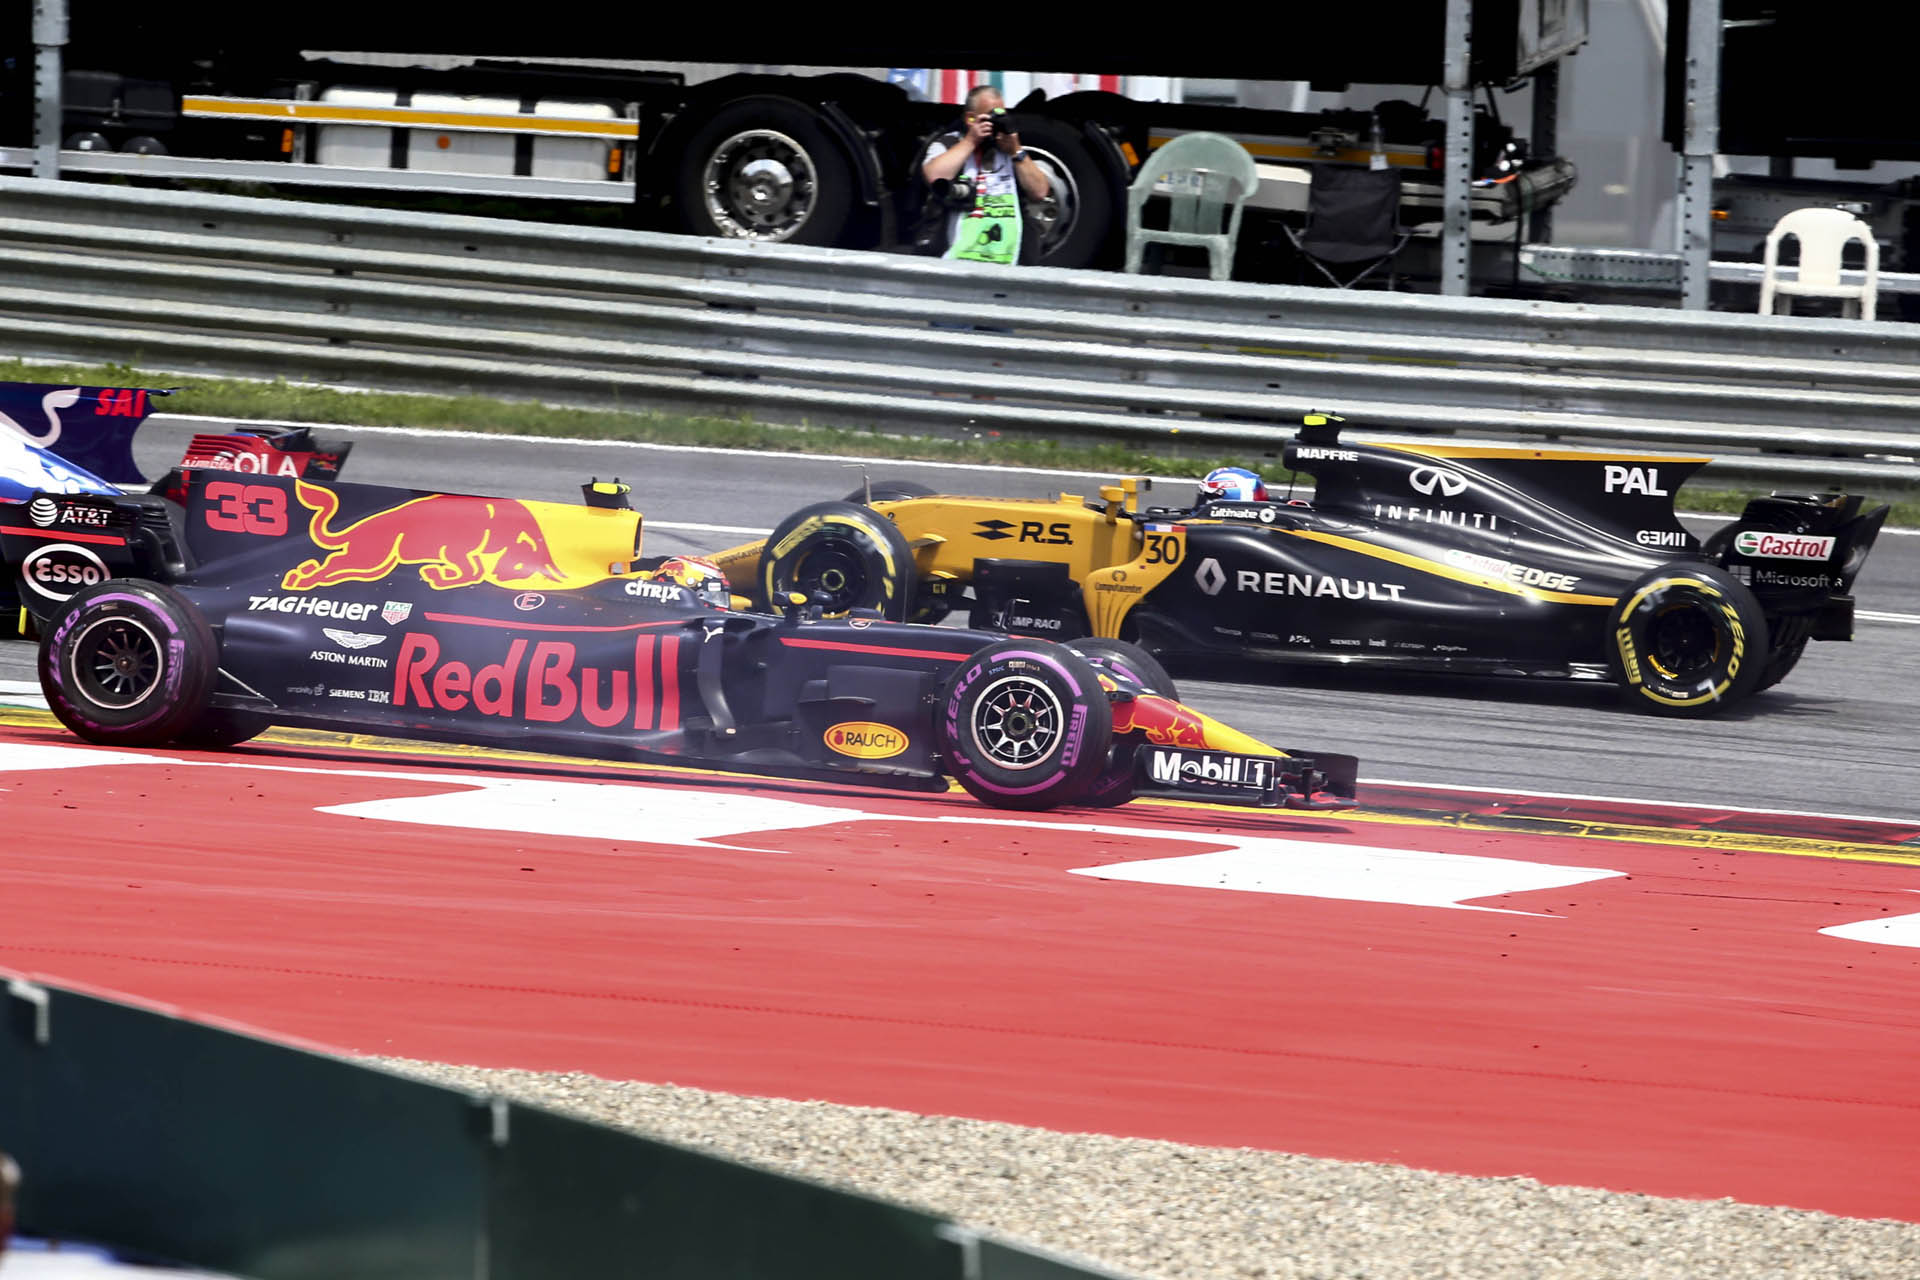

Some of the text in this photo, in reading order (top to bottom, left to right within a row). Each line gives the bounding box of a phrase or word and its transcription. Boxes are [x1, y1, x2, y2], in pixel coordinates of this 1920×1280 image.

[94, 388, 147, 418] SAI
[1295, 447, 1359, 462] MAPFRE
[1603, 465, 1668, 497] PAL
[60, 506, 113, 526] AT&T
[205, 481, 288, 536] 33
[1374, 504, 1497, 530] INFINITI
[1146, 535, 1180, 565] 30
[1760, 536, 1828, 558] Castrol
[1237, 570, 1406, 601] RENAULT
[1508, 564, 1581, 592] EDGE
[1756, 570, 1830, 587] Microsoft
[310, 650, 388, 668] ASTON MARTIN
[328, 688, 366, 700] SIEMENS
[367, 689, 390, 704] IBM
[946, 664, 982, 740] ZERO
[845, 733, 897, 749] RAUCH
[1060, 704, 1088, 767] PIRELLI
[1153, 751, 1264, 787] Mobil 1
